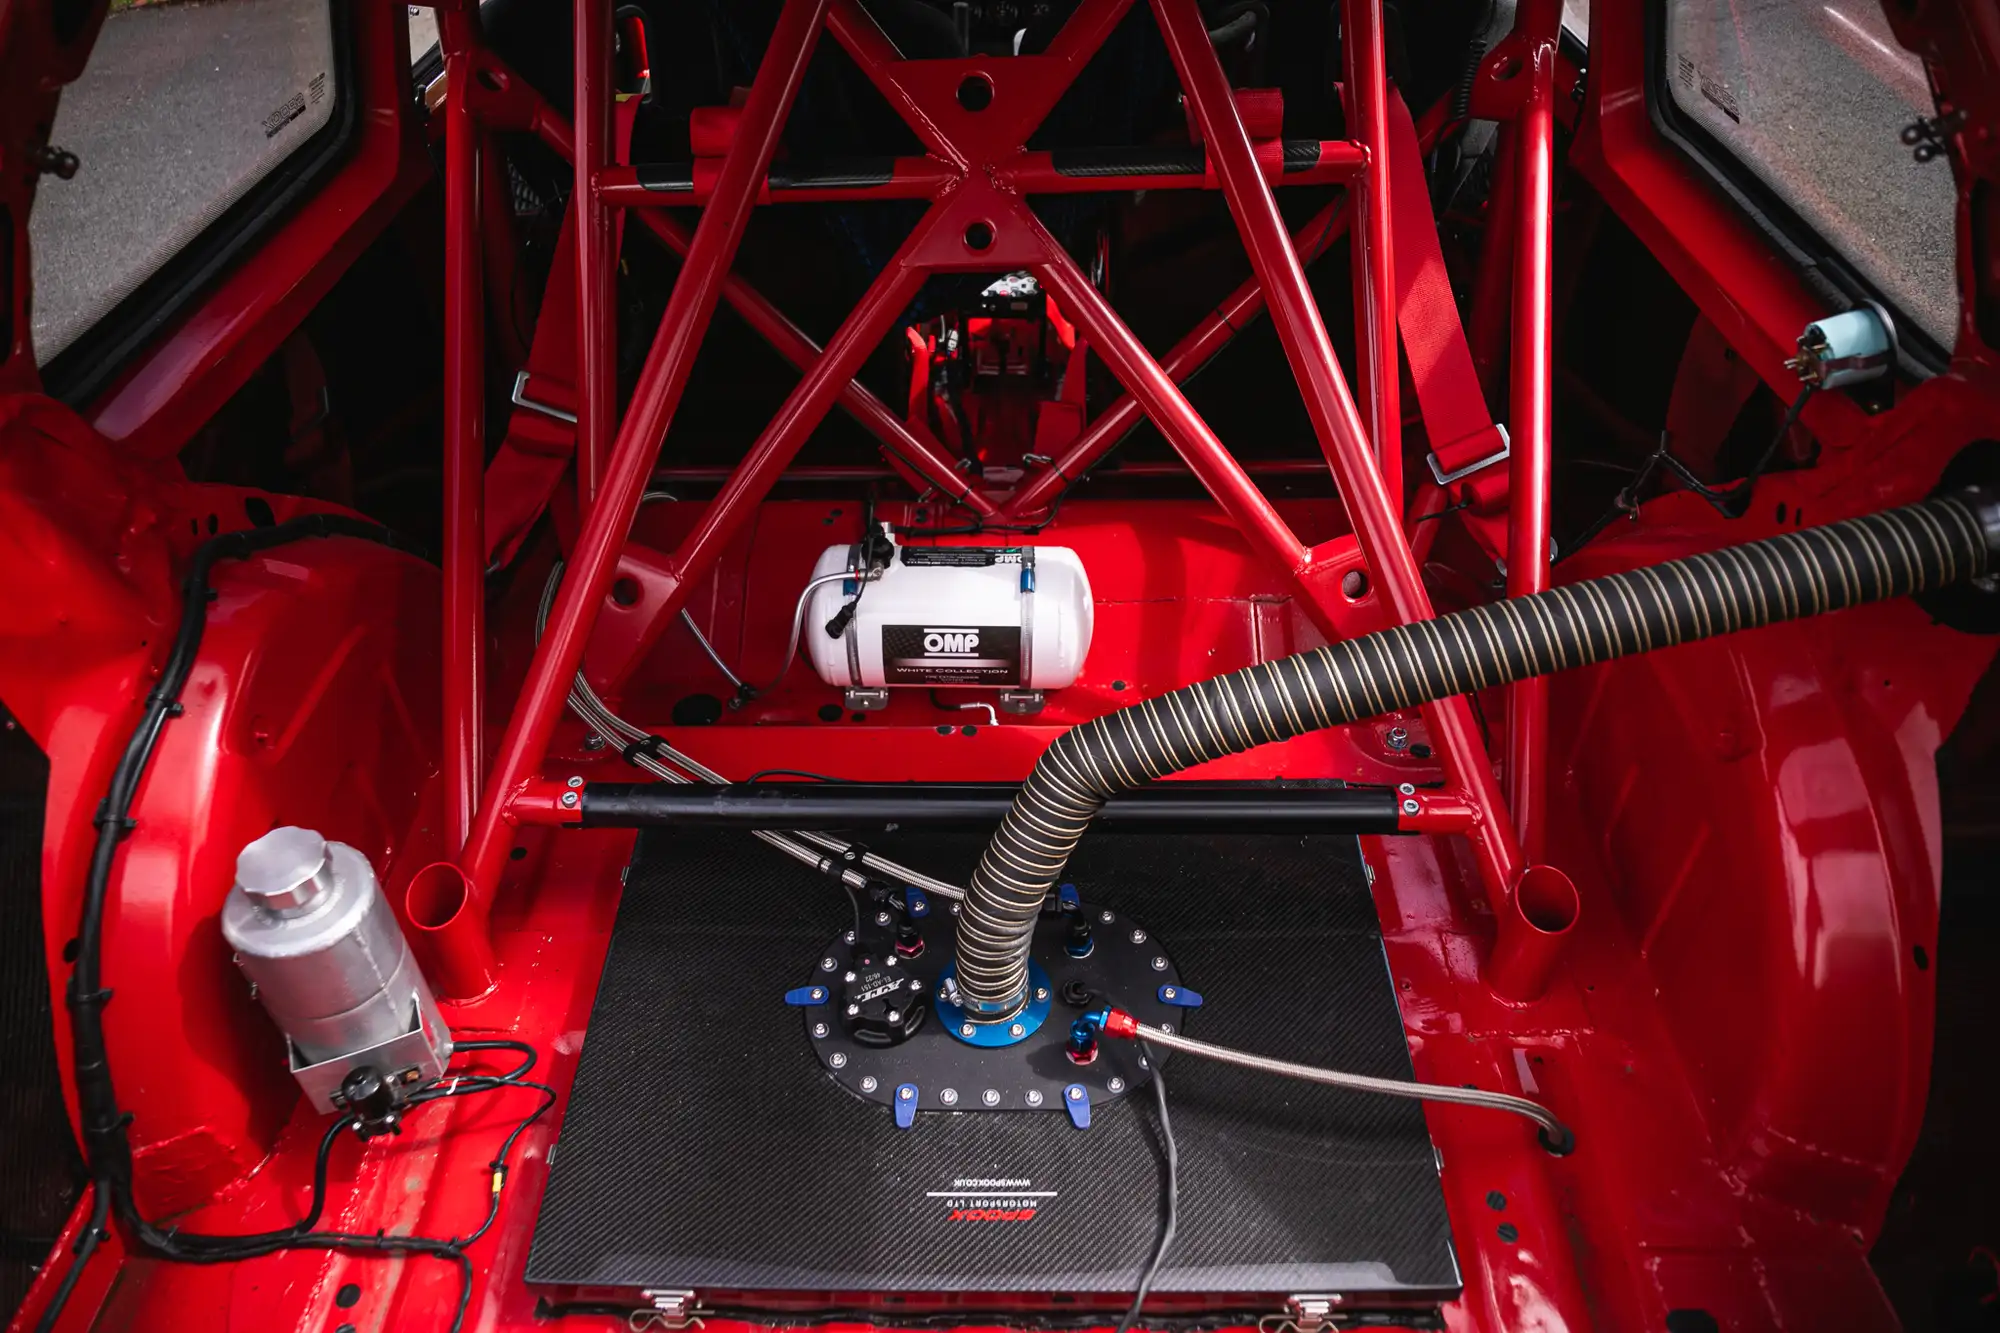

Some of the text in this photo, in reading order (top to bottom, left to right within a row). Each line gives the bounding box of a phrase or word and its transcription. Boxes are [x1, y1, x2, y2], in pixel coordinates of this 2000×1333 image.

[924, 633, 979, 653] OMP
[946, 1199, 1037, 1208] MOTORSPORT LTD
